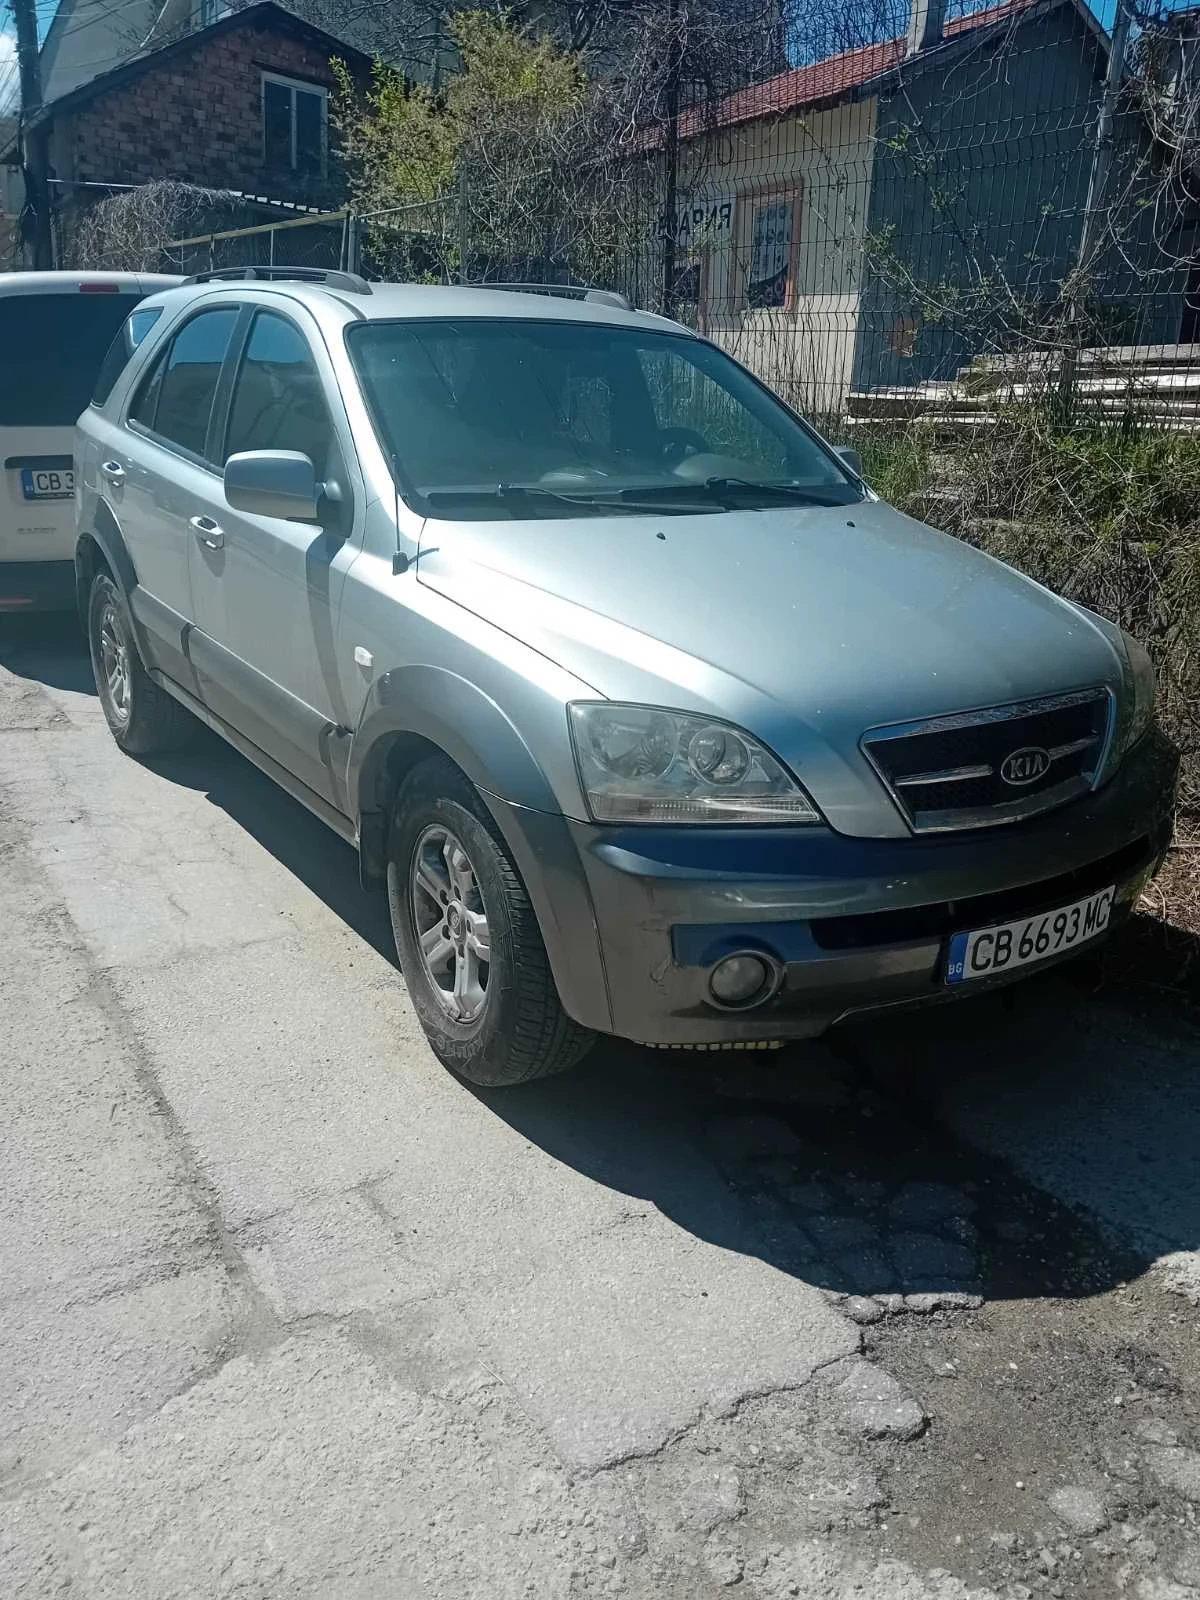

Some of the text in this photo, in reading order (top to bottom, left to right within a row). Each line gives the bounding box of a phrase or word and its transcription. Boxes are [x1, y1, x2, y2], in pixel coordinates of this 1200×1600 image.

[36, 472, 62, 491] CB
[1010, 754, 1043, 779] KIA
[971, 892, 1111, 972] CB 6693 MC
[948, 963, 964, 976] BG
